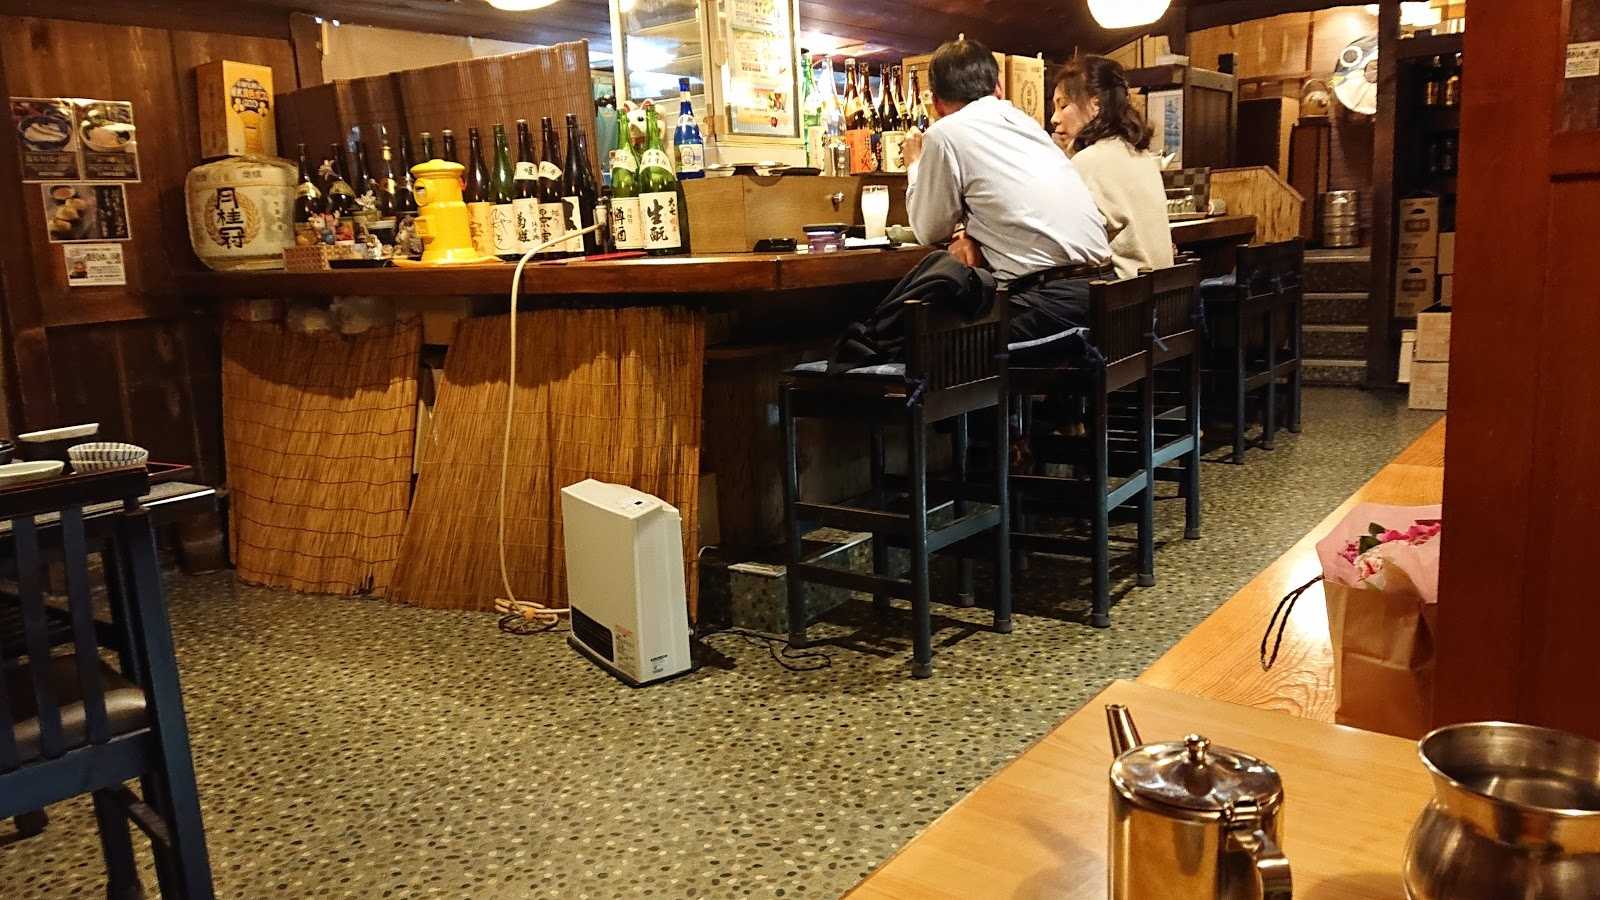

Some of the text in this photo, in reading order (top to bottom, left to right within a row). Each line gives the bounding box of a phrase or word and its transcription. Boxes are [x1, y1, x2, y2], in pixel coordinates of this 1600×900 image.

[216, 187, 245, 248] 月桂冠
[647, 199, 668, 242] 生酛
